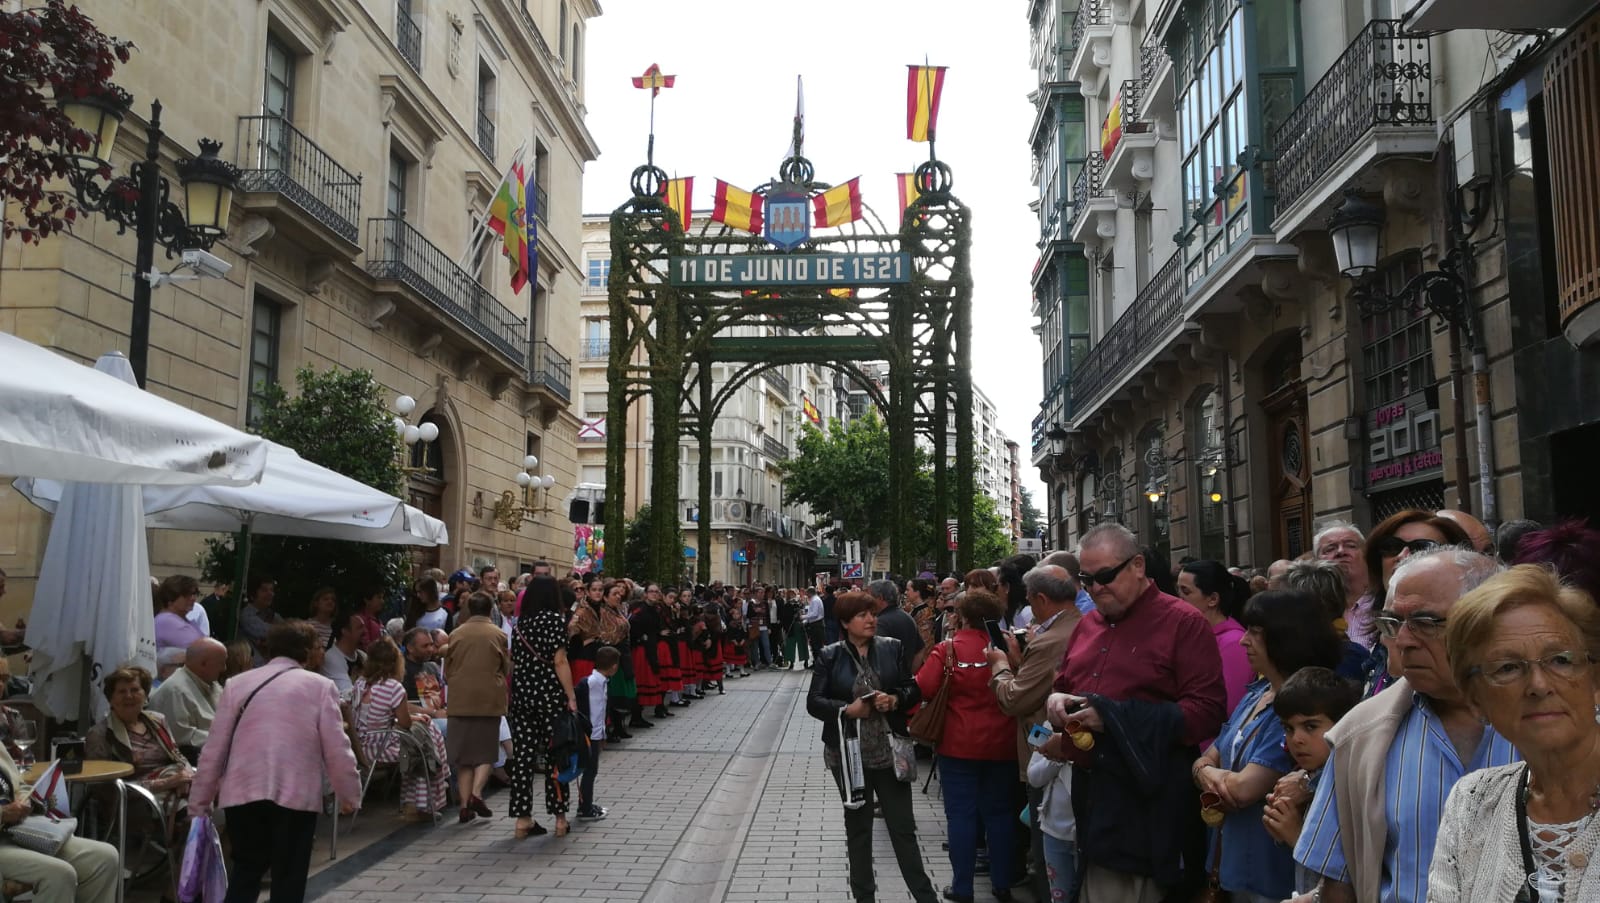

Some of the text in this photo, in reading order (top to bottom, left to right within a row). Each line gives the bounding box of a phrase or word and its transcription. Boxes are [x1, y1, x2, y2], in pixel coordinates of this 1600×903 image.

[680, 257, 901, 282] 11 DE JUNIO DE 1521
[1369, 409, 1438, 462] adn
